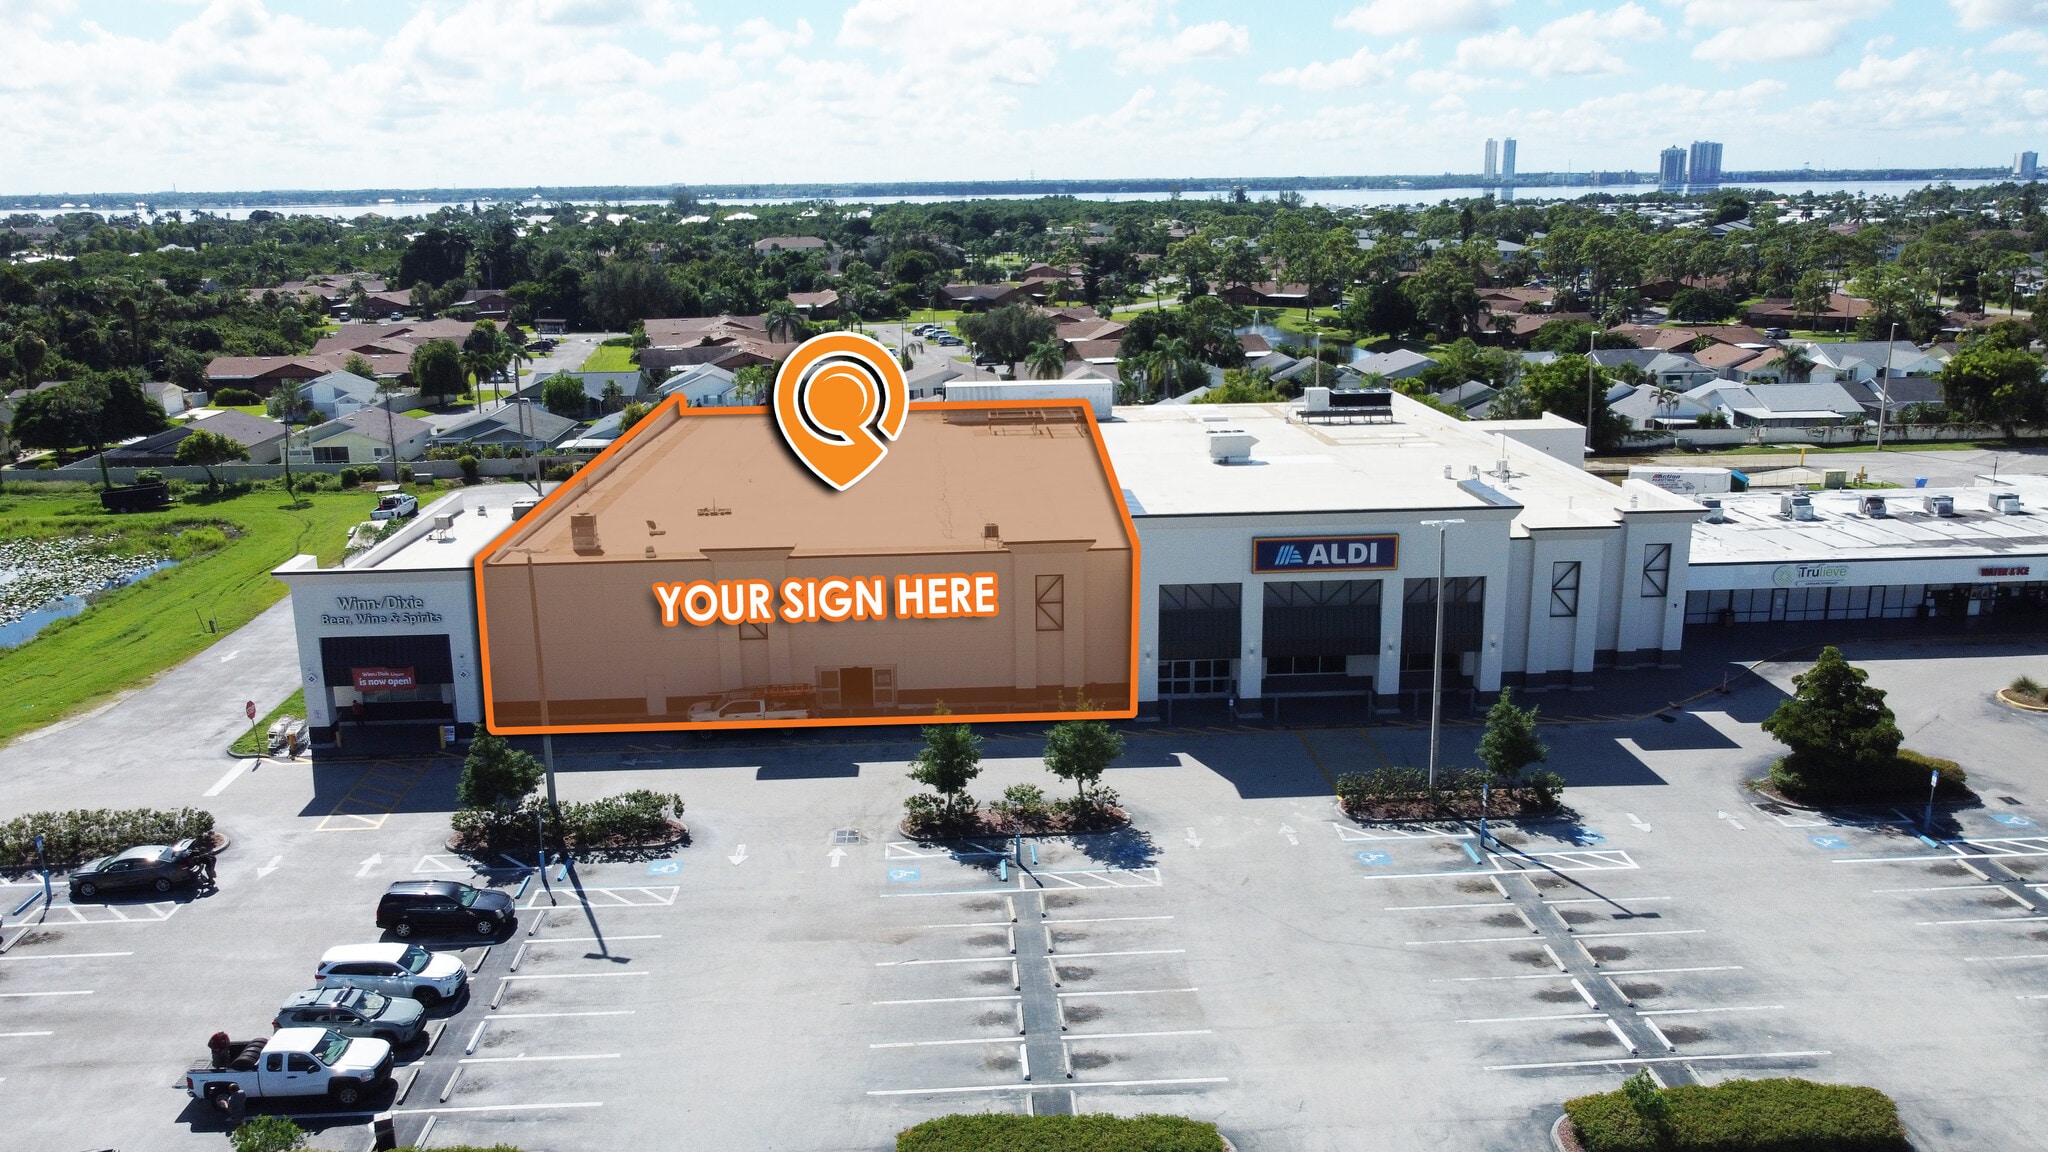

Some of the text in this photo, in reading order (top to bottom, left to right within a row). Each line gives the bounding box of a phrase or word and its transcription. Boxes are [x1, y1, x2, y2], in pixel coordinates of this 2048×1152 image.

[1307, 542, 1378, 565] ALDI
[1799, 566, 1848, 578] Trulieve
[321, 611, 442, 626] Beer, Wine & Spirits
[359, 677, 367, 686] is
[387, 676, 412, 687] open!
